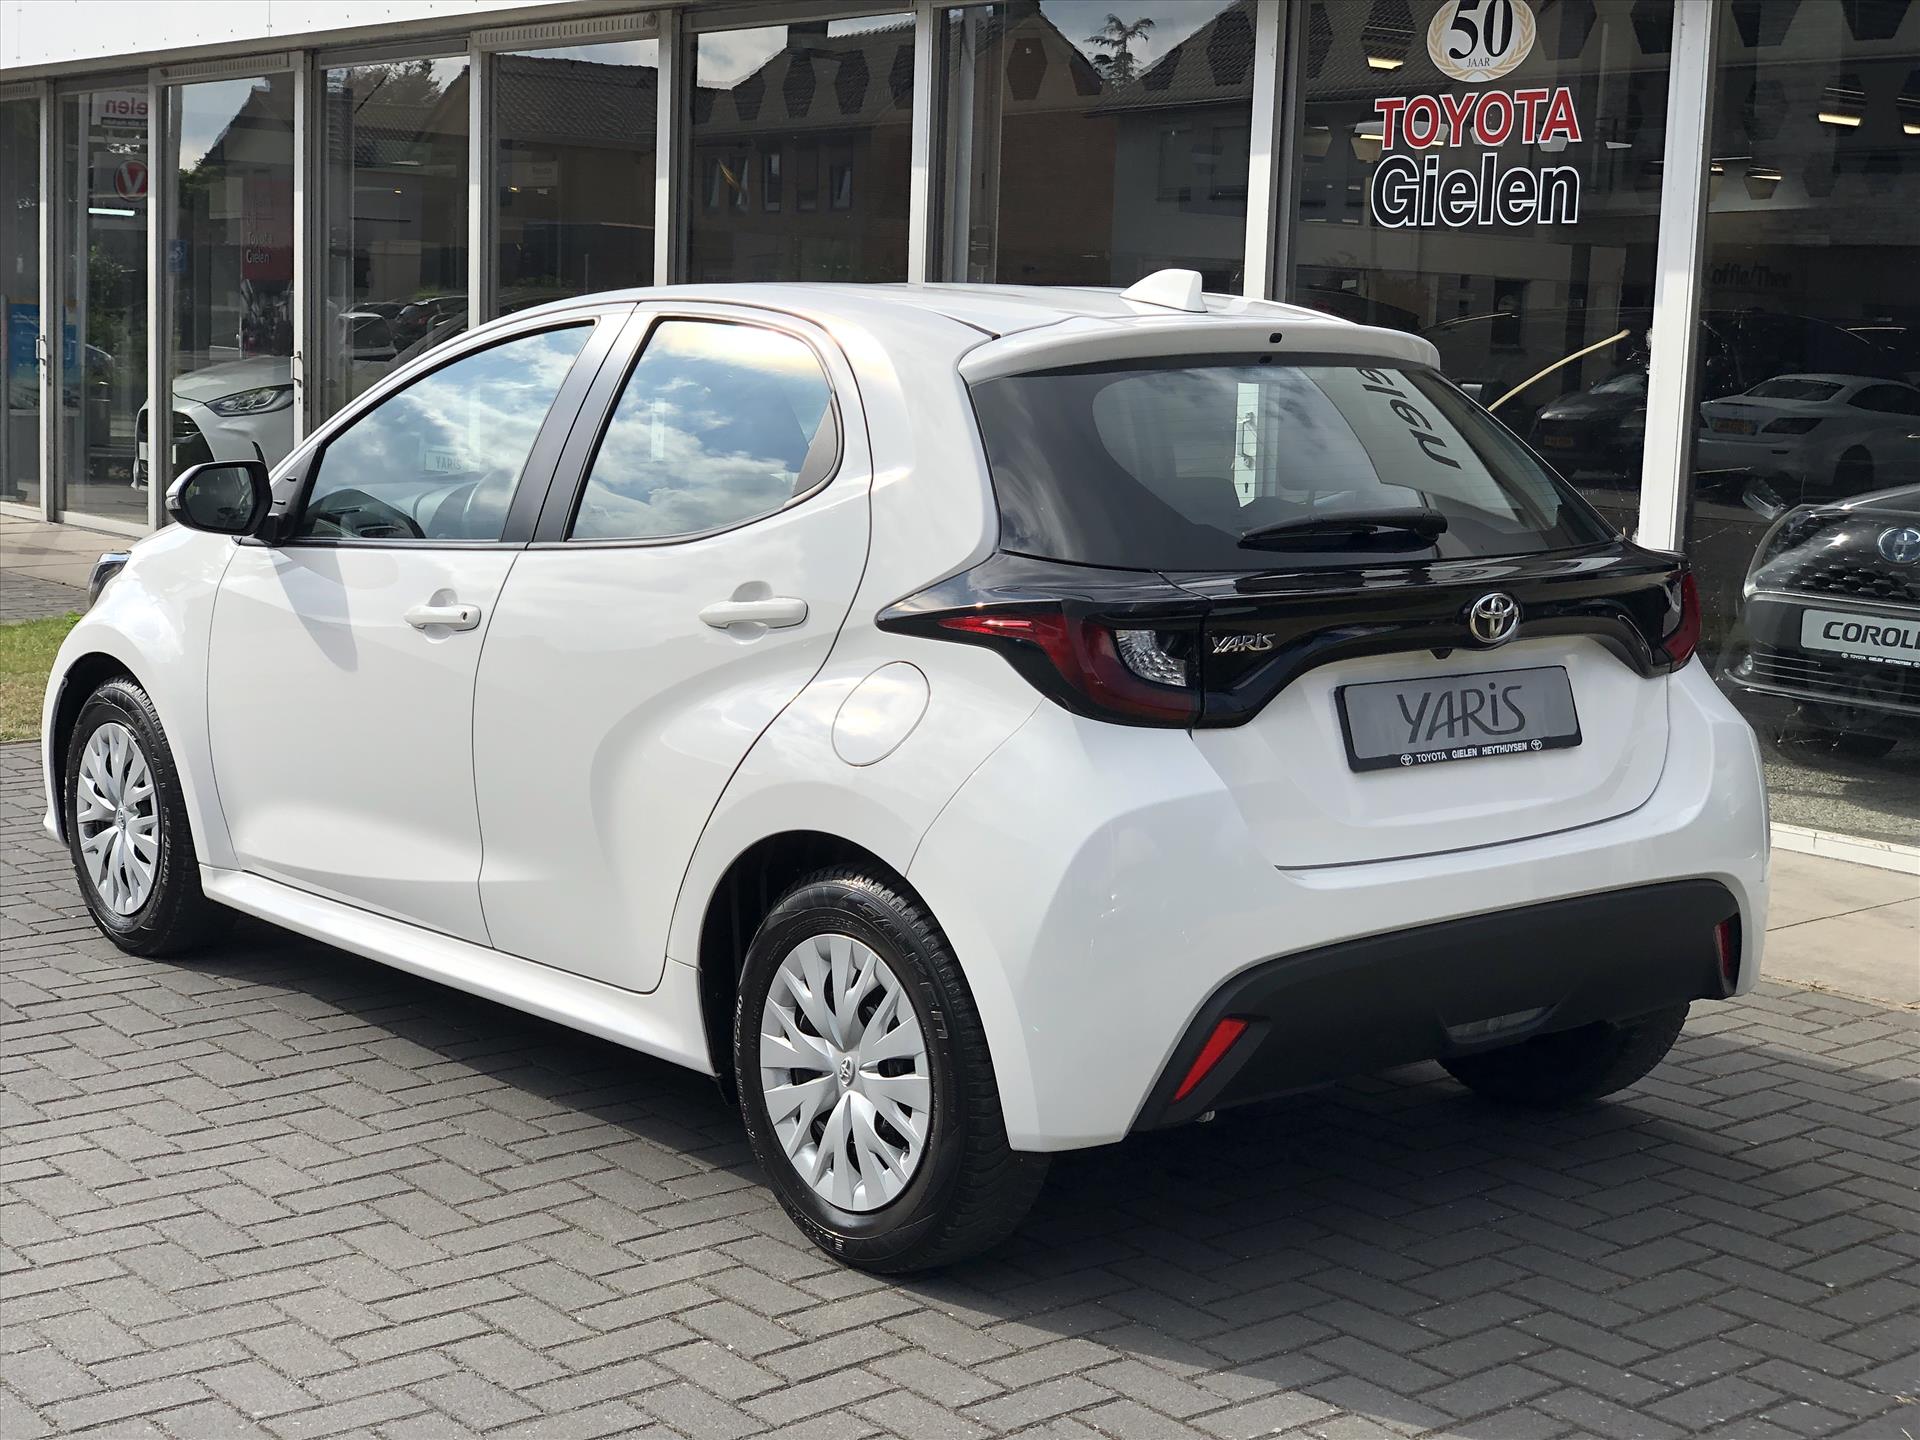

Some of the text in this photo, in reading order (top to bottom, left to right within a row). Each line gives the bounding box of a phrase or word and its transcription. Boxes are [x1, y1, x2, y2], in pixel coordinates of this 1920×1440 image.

[1448, 0, 1513, 60] 50
[1467, 57, 1490, 68] JAAR
[1373, 85, 1582, 150] TOYOTA
[1370, 153, 1582, 228] Gielen
[1416, 741, 1528, 763] TOYOTA GIELEN HEYTHUYSEN
